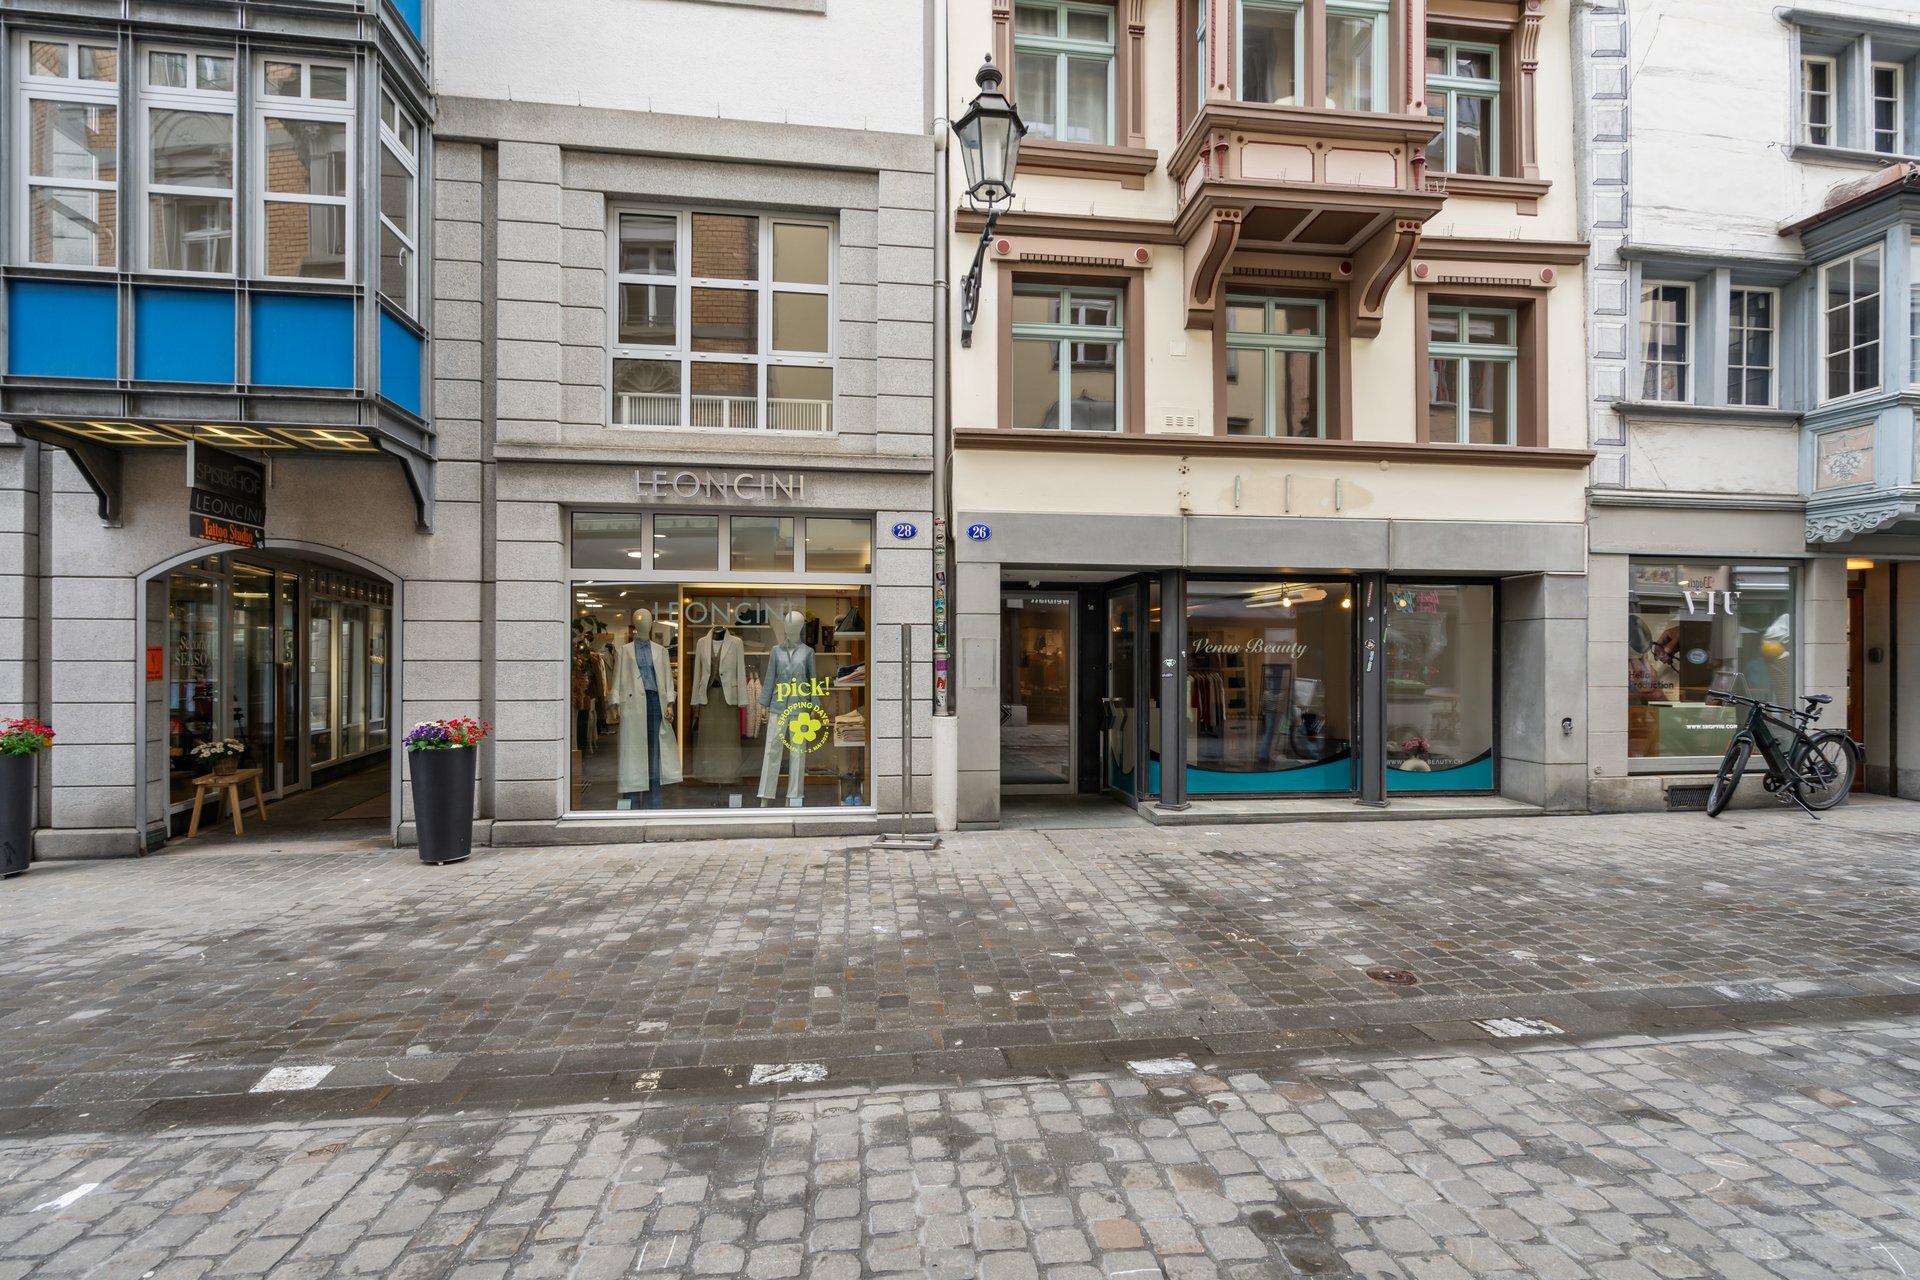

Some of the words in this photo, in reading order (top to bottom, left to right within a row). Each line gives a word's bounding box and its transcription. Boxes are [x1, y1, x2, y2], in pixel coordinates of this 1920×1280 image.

[634, 469, 804, 500] LEONCINI
[195, 494, 262, 523] LEONCINI
[203, 518, 228, 539] Tattoo
[229, 523, 253, 543] Studio
[897, 524, 912, 537] 28
[972, 526, 987, 539] 26
[654, 601, 793, 624] LEONCINI
[1683, 591, 1742, 615] VIU
[179, 636, 209, 650] Secon
[1192, 638, 1241, 654] Venus
[1245, 638, 1308, 660] Beauty
[174, 652, 212, 666] SEASO
[776, 676, 830, 702] pick!
[778, 701, 813, 726] SHOPPING
[813, 705, 830, 725] DAYS
